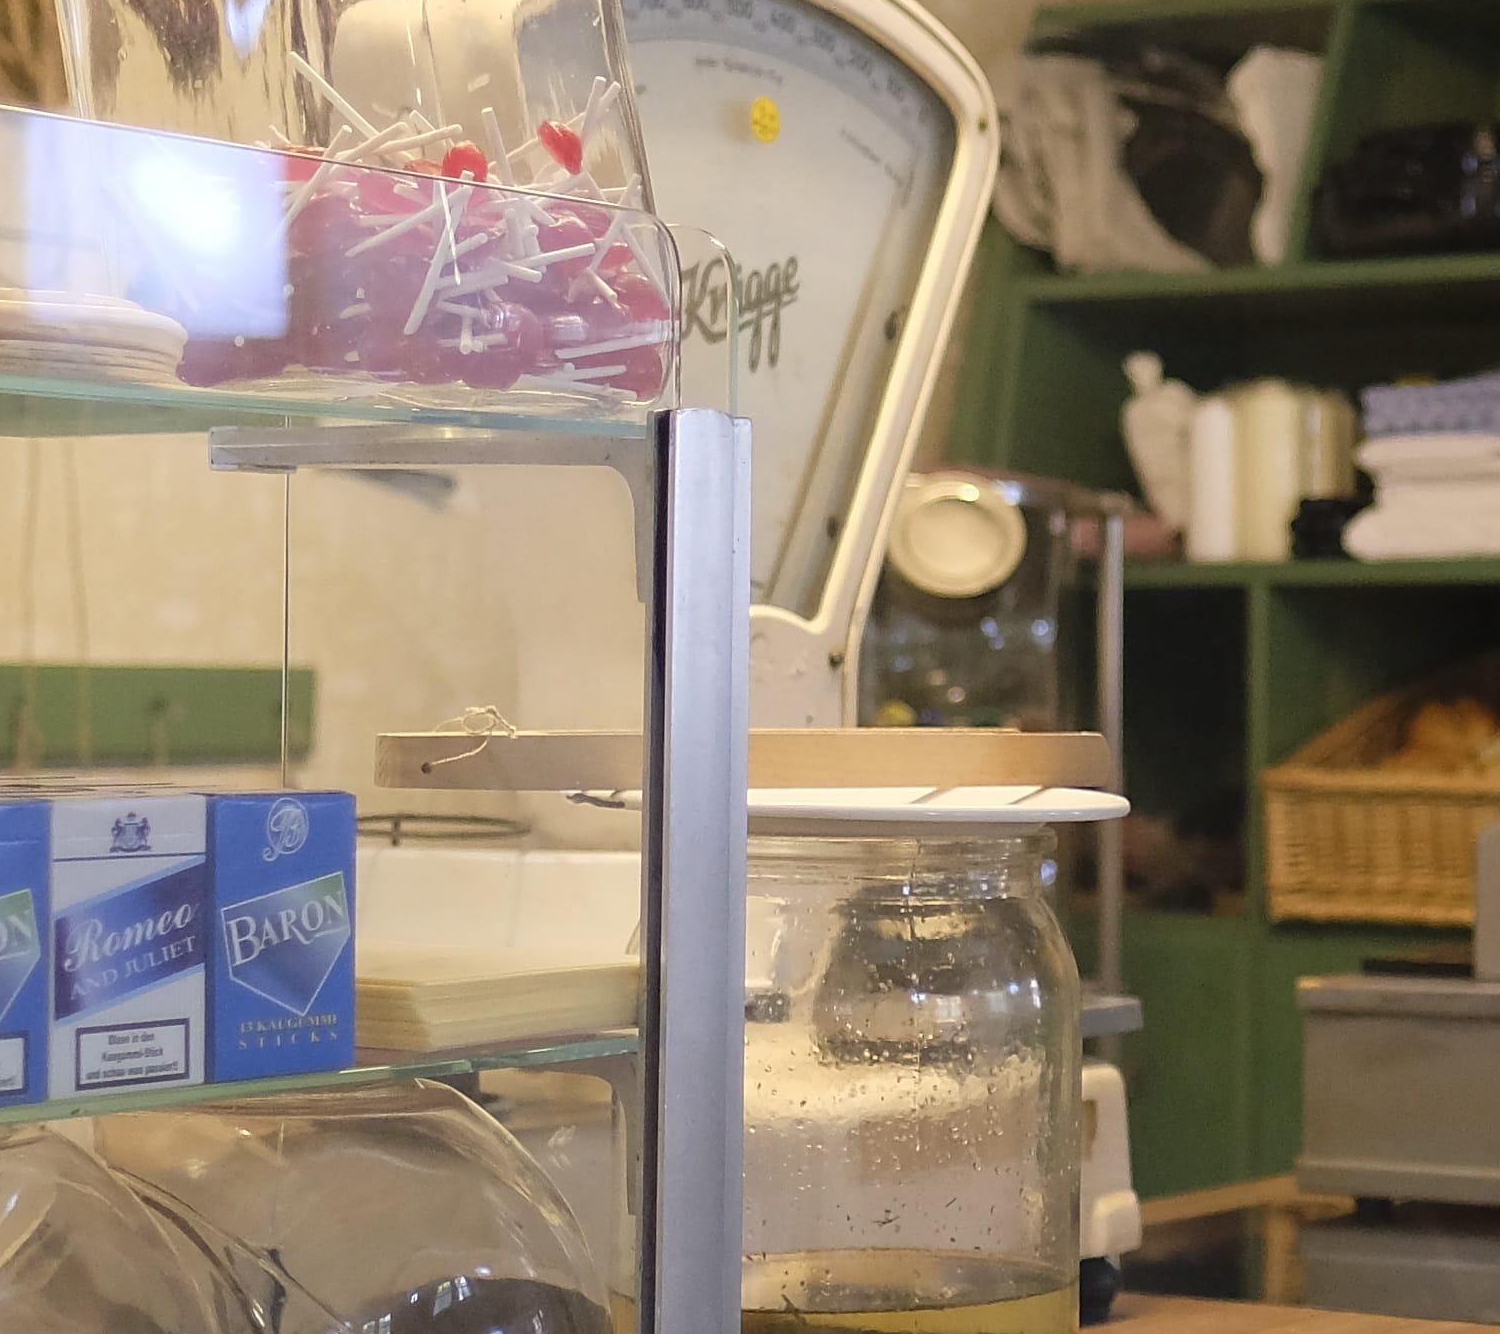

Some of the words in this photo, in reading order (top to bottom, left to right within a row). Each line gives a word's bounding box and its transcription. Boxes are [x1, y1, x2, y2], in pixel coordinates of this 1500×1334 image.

[64, 903, 199, 973] Romeo
[227, 890, 344, 968] BARON
[70, 968, 119, 1001] AND
[125, 935, 196, 978] JULIET
[238, 1030, 338, 1051] STICKS
[256, 1014, 338, 1033] KAUGUMMI
